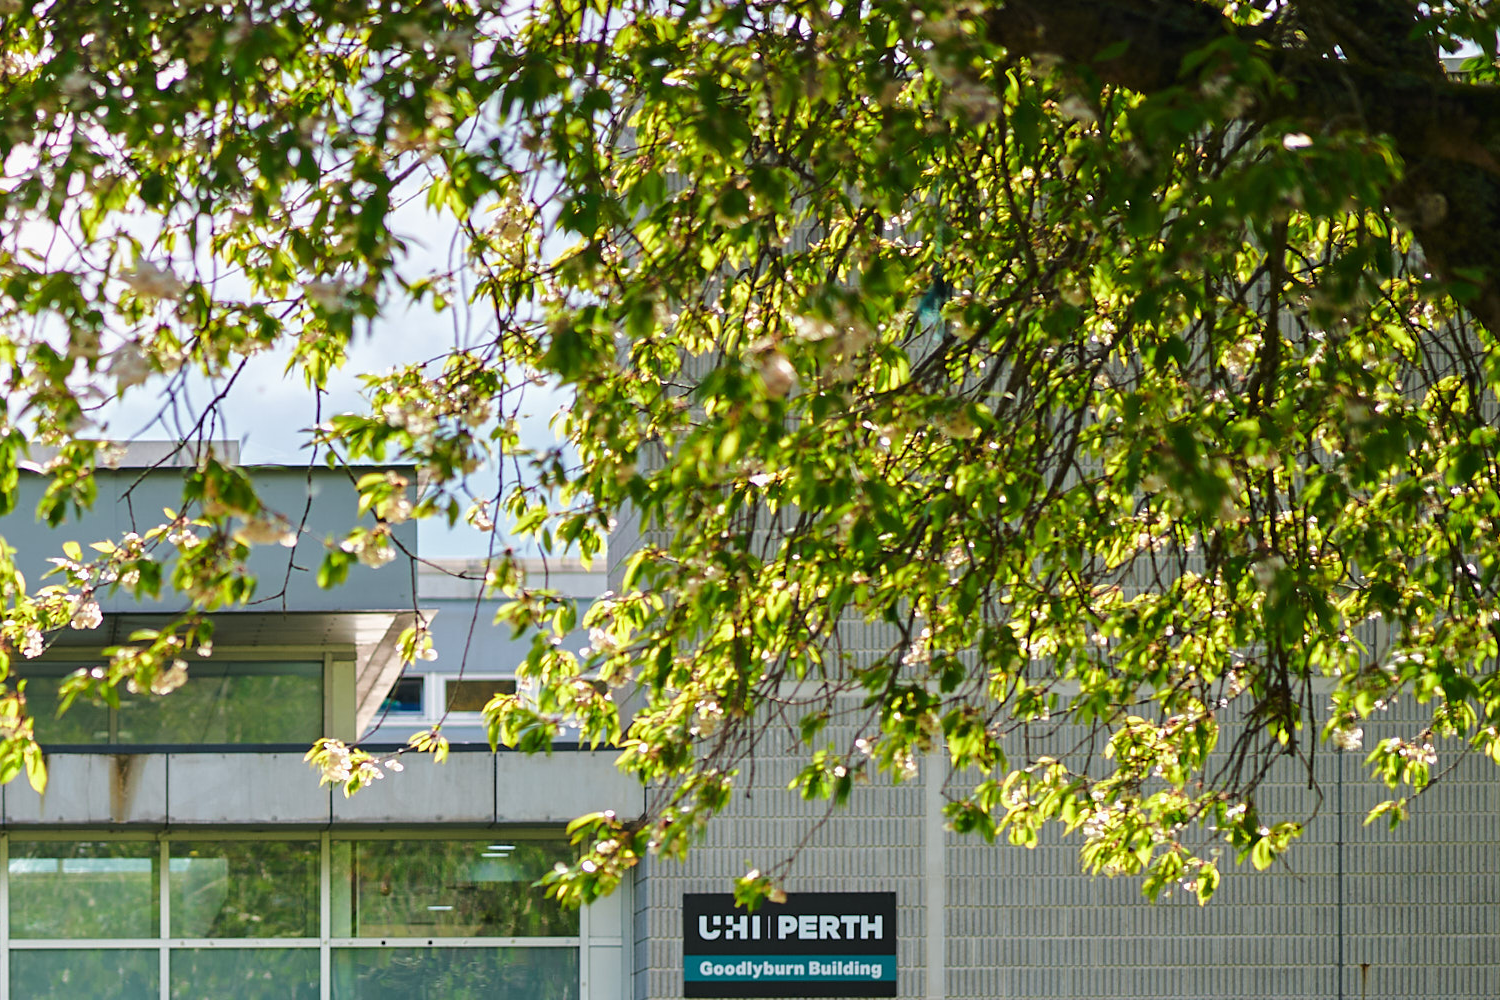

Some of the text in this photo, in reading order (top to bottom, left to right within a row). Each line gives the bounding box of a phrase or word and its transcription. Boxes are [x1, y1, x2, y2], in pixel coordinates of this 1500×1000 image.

[698, 914, 883, 940] UHI PERTH
[699, 960, 883, 979] Goodlyburn Building
